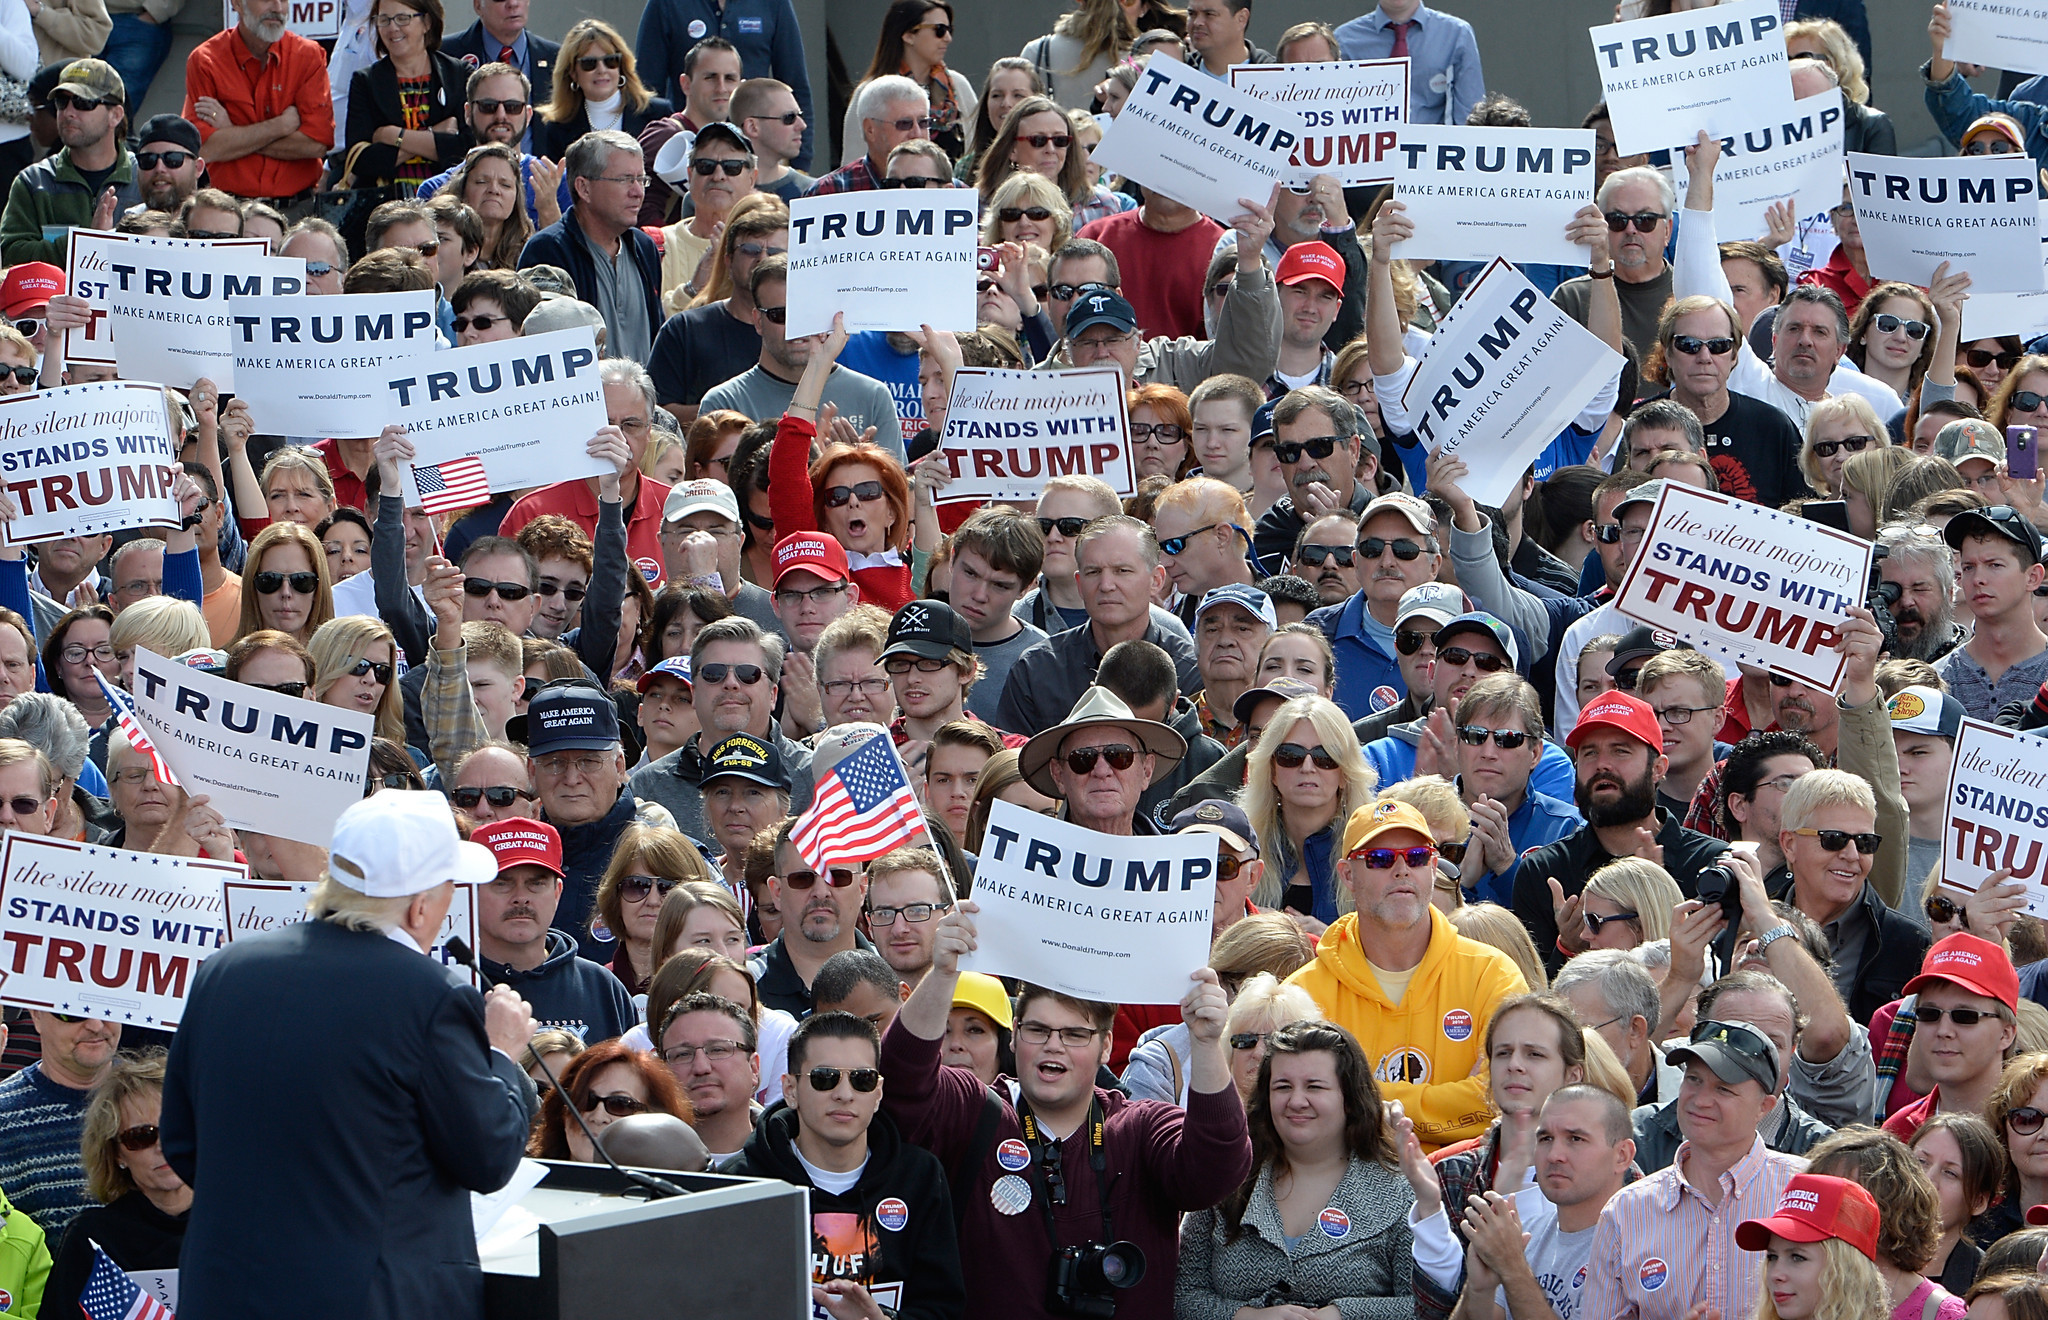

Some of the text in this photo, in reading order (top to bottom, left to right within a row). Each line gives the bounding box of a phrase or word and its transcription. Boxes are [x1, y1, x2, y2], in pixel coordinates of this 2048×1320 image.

[1981, 4, 2030, 18] AMERICA
[1599, 14, 1778, 68] TRUMP
[1607, 51, 1784, 92] MAKE AMERICA GREAT AGAIN!
[1272, 79, 1401, 104] silent majority
[1668, 96, 1731, 112] www.DonaldJTrump.com
[1146, 68, 1295, 152] TRUMP
[1342, 106, 1400, 124] WITH
[1126, 102, 1280, 179] MAKE AMERICA GREAT AGAIN!
[1400, 144, 1591, 174] TRUMP
[1716, 154, 1807, 182] AMERICA GREAT
[1398, 184, 1590, 200] MAKE AMERICA GREAT AGAIN!
[1854, 170, 2034, 204] TRUMP
[792, 209, 974, 244] TRUMP
[1456, 220, 1527, 228] www.DonaldJTrump.com
[1859, 208, 2036, 228] MAKE AMERICA GREAT AGAIN!
[790, 251, 972, 271] MAKE AMERICA GREAT AGAIN!
[1912, 249, 1977, 258] www.DonaldJTrump.com
[112, 264, 302, 300] TRUMP
[112, 304, 202, 326] MAKE AMERICA
[234, 311, 431, 344] TRUMP
[236, 357, 271, 369] MAKE
[275, 358, 336, 369] AMERICA
[340, 356, 383, 368] GREAT
[1417, 288, 1538, 443] TRUMP
[388, 348, 594, 408] TRUMP
[1458, 316, 1568, 438] AMERICA GREAT AGAIN!
[396, 391, 600, 434] AKE AMERICA GREAT AGAIN!
[952, 388, 1112, 415] the silent majority
[32, 410, 88, 436] silent
[93, 404, 162, 430] majority
[946, 416, 1116, 439] STANDS WITH
[2, 435, 169, 472] STANDS WITH
[464, 439, 541, 457] www.DonaldJTrump.com
[942, 443, 1120, 479] TRUMP
[8, 464, 173, 516] TRUMP
[684, 488, 718, 498] CREATOR
[778, 540, 826, 558] MAKE AMERICA
[779, 548, 824, 564] GREAT AGAIN
[1663, 510, 1858, 588] the silent majority
[1652, 542, 1853, 618] STANDS WITH
[1642, 566, 1844, 656] TRUMP
[138, 666, 366, 754] TRUMP
[540, 707, 596, 720] MAKE AMERICA
[1588, 704, 1634, 715] MAKE AMERICA
[1895, 708, 1918, 716] Shops
[544, 717, 593, 728] GREAT AGAIN
[136, 706, 361, 784] MAKE AMERICA GREAT AGAIN!
[712, 738, 768, 760] USS FORRESTAL
[1961, 746, 2046, 790] the silent
[192, 773, 280, 798] www.DonaldJTrump.com
[1954, 783, 2048, 829] STANDS
[488, 831, 550, 844] MAKE AMERICA
[494, 840, 546, 852] GREAT AGAIN
[990, 824, 1212, 892] TRUMP
[14, 861, 130, 899] the silent
[976, 876, 1208, 924] MAKE AMERICA GREAT AGAIN!
[8, 897, 140, 936] STANDS
[238, 906, 274, 931] the
[1041, 938, 1131, 958] www.DonaldJTrump.com
[1933, 950, 1982, 962] MAKE AMERICA
[3, 930, 203, 999] TRUM
[1954, 956, 1977, 966] AGAIN
[1024, 1115, 1036, 1140] Nikon
[1093, 1122, 1102, 1145] Nikon
[1004, 1143, 1027, 1152] TRUMP
[995, 1180, 1026, 1208] TRUMP
[1788, 1200, 1816, 1212] AGAIN
[1324, 1211, 1346, 1220] TRUMP
[812, 1253, 864, 1276] HUF
